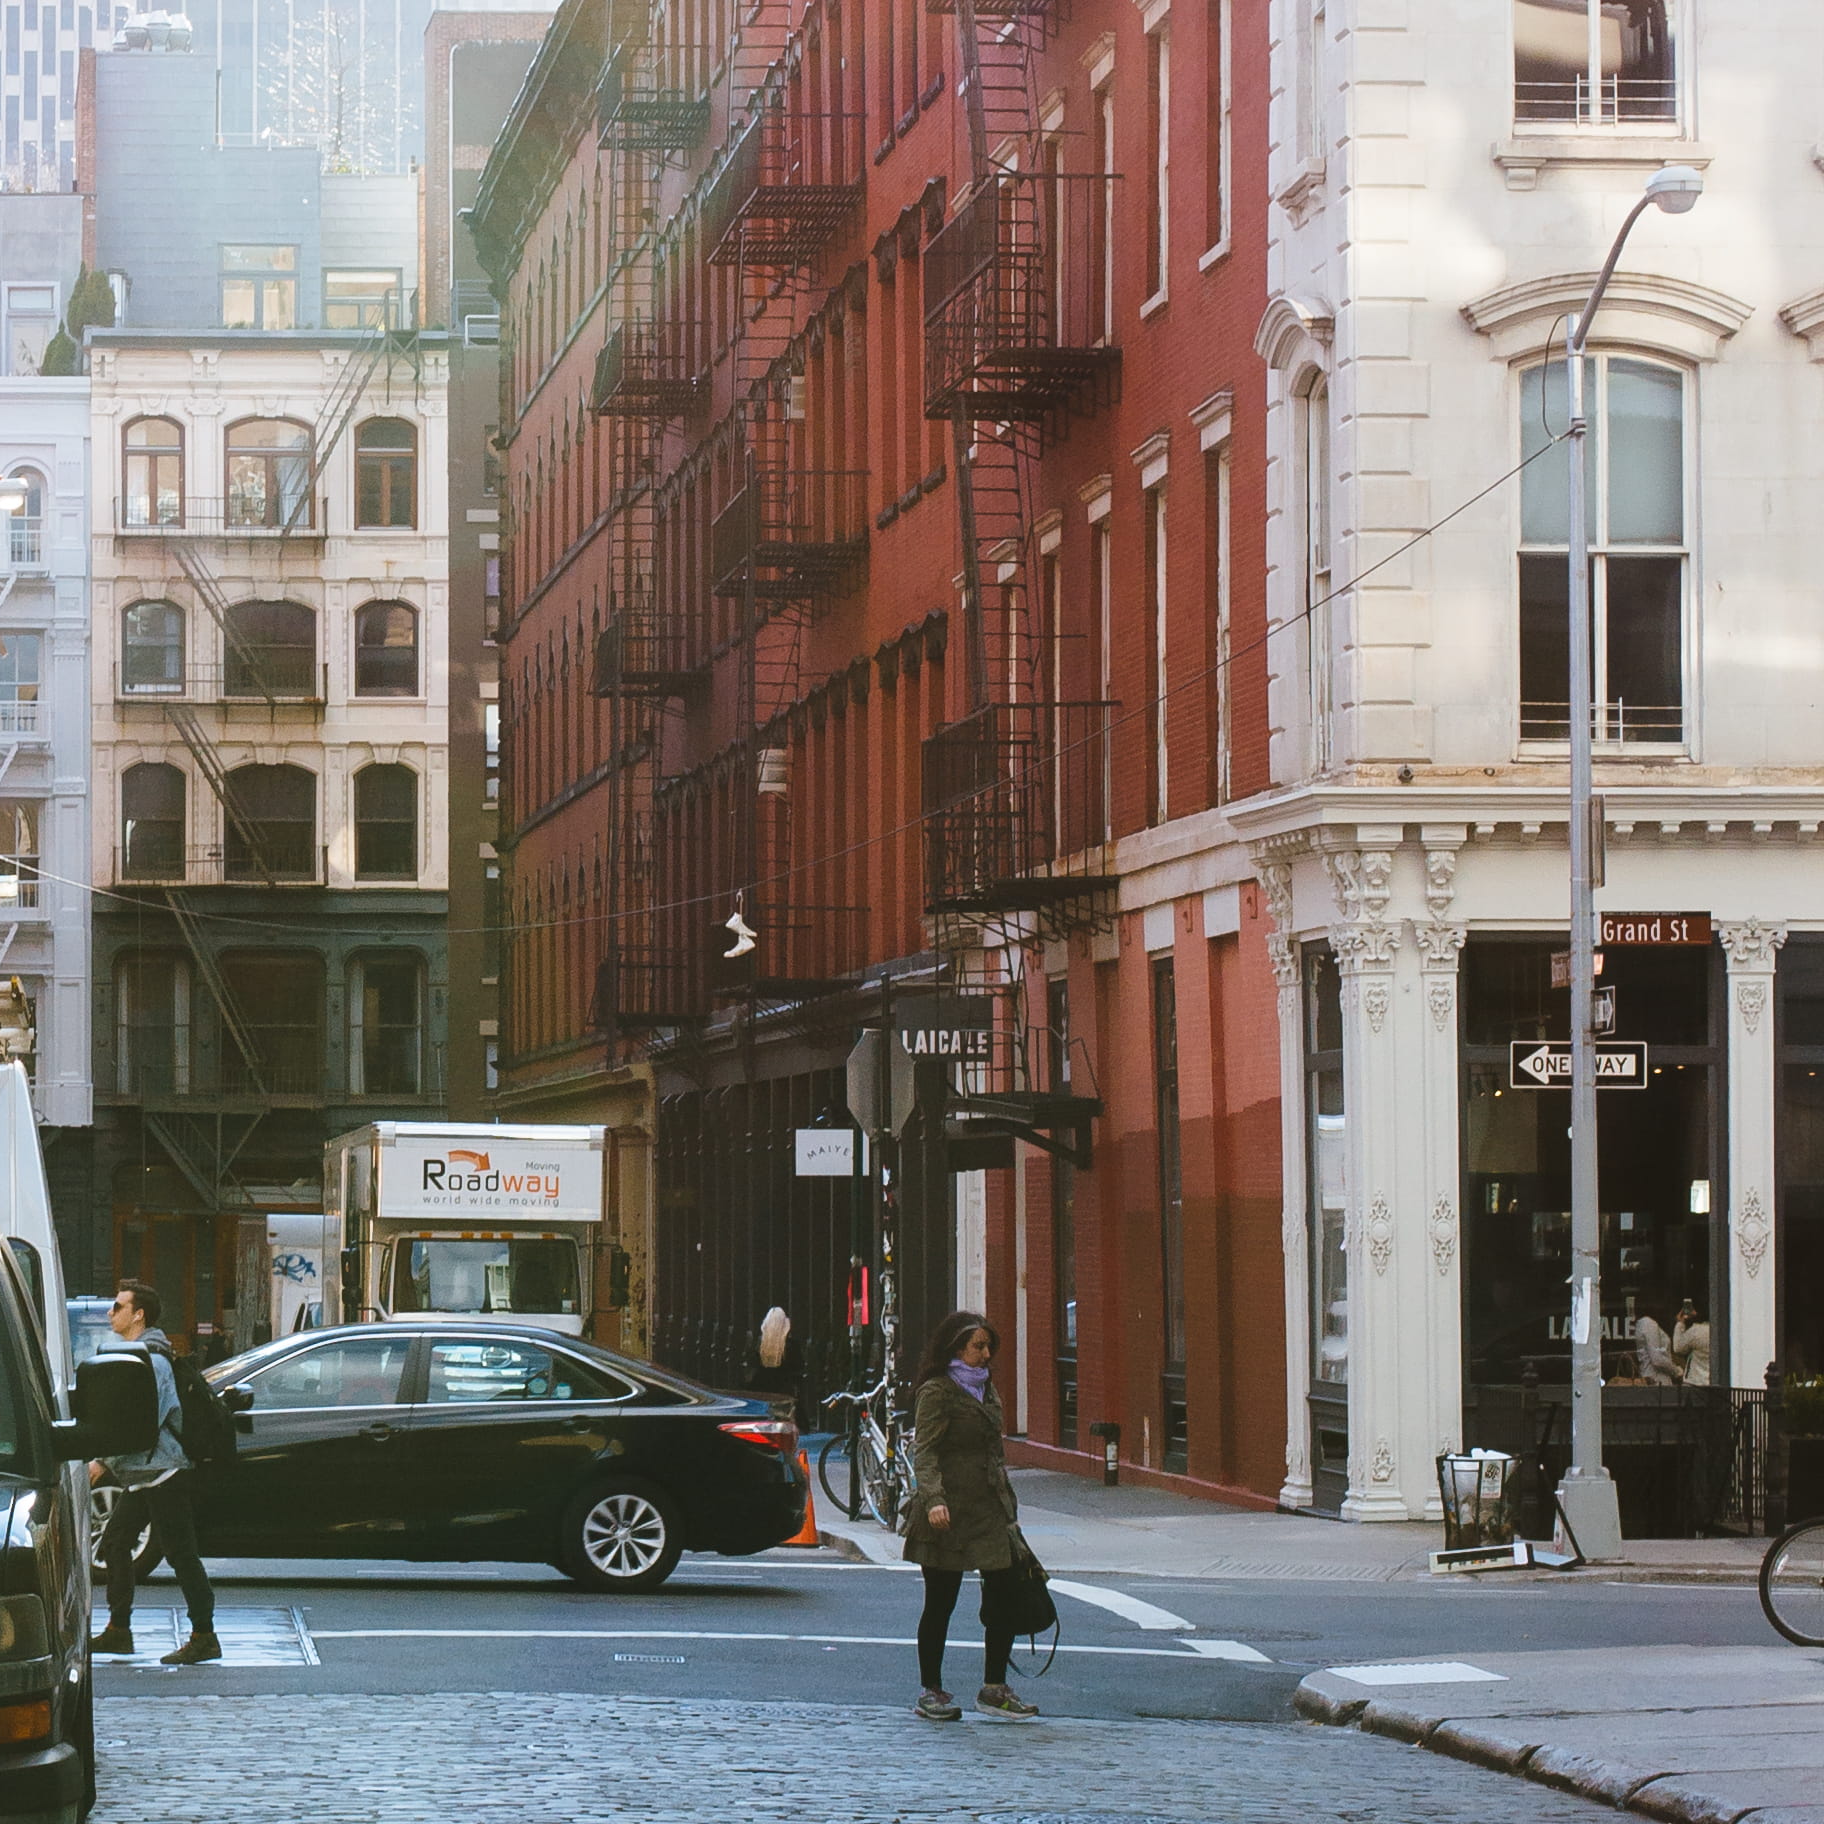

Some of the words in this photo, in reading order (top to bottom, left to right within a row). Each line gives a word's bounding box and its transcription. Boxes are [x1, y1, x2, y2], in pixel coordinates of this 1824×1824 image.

[1603, 918, 1661, 942] Grand
[1670, 919, 1688, 941] St
[1532, 1057, 1569, 1073] ONE
[526, 1161, 561, 1172] Moving
[423, 1159, 560, 1199] Roadway
[423, 1196, 461, 1205] world
[469, 1196, 501, 1206] wide
[509, 1197, 560, 1208] moving
